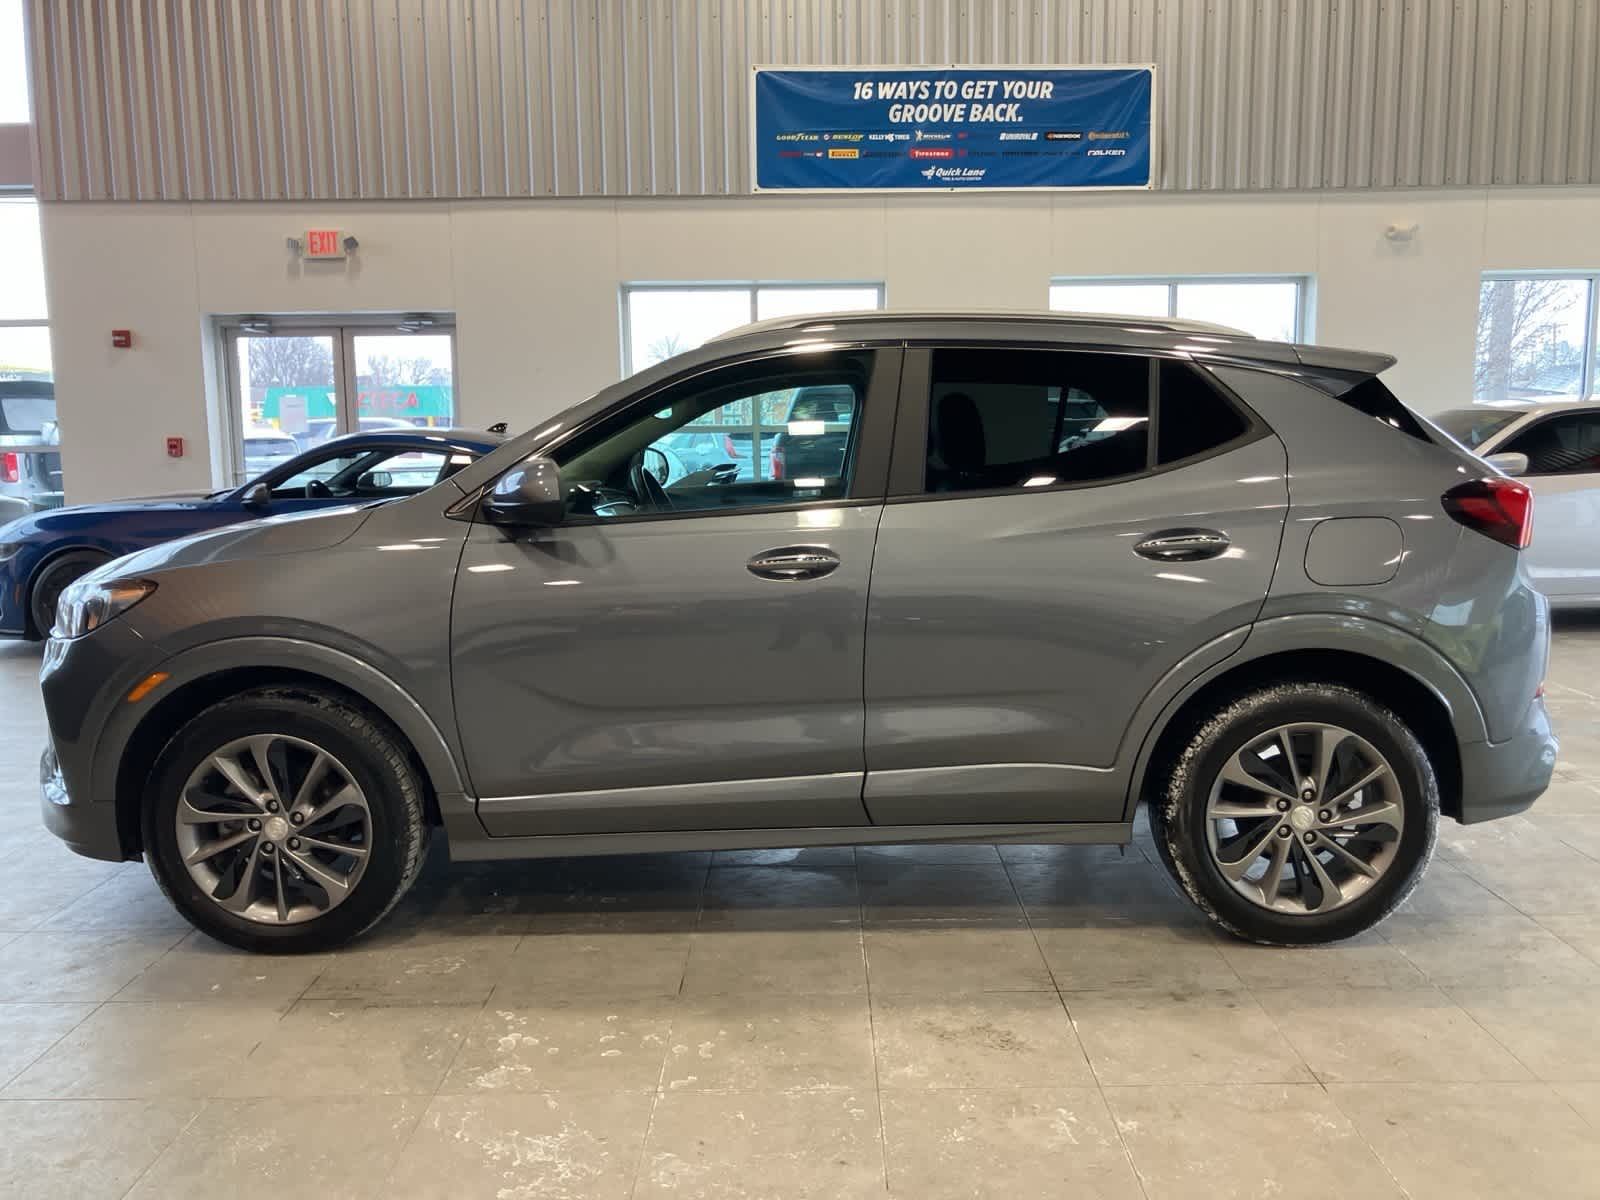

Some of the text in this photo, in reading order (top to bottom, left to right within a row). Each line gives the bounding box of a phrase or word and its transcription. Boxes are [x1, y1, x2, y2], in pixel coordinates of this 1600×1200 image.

[853, 80, 1054, 100] 16 WAYS TO GET YOUR
[888, 103, 1024, 123] GROOVE BACK.
[1087, 149, 1126, 157] FALKEN
[935, 167, 986, 177] Quick Lane
[308, 230, 338, 255] EXIT
